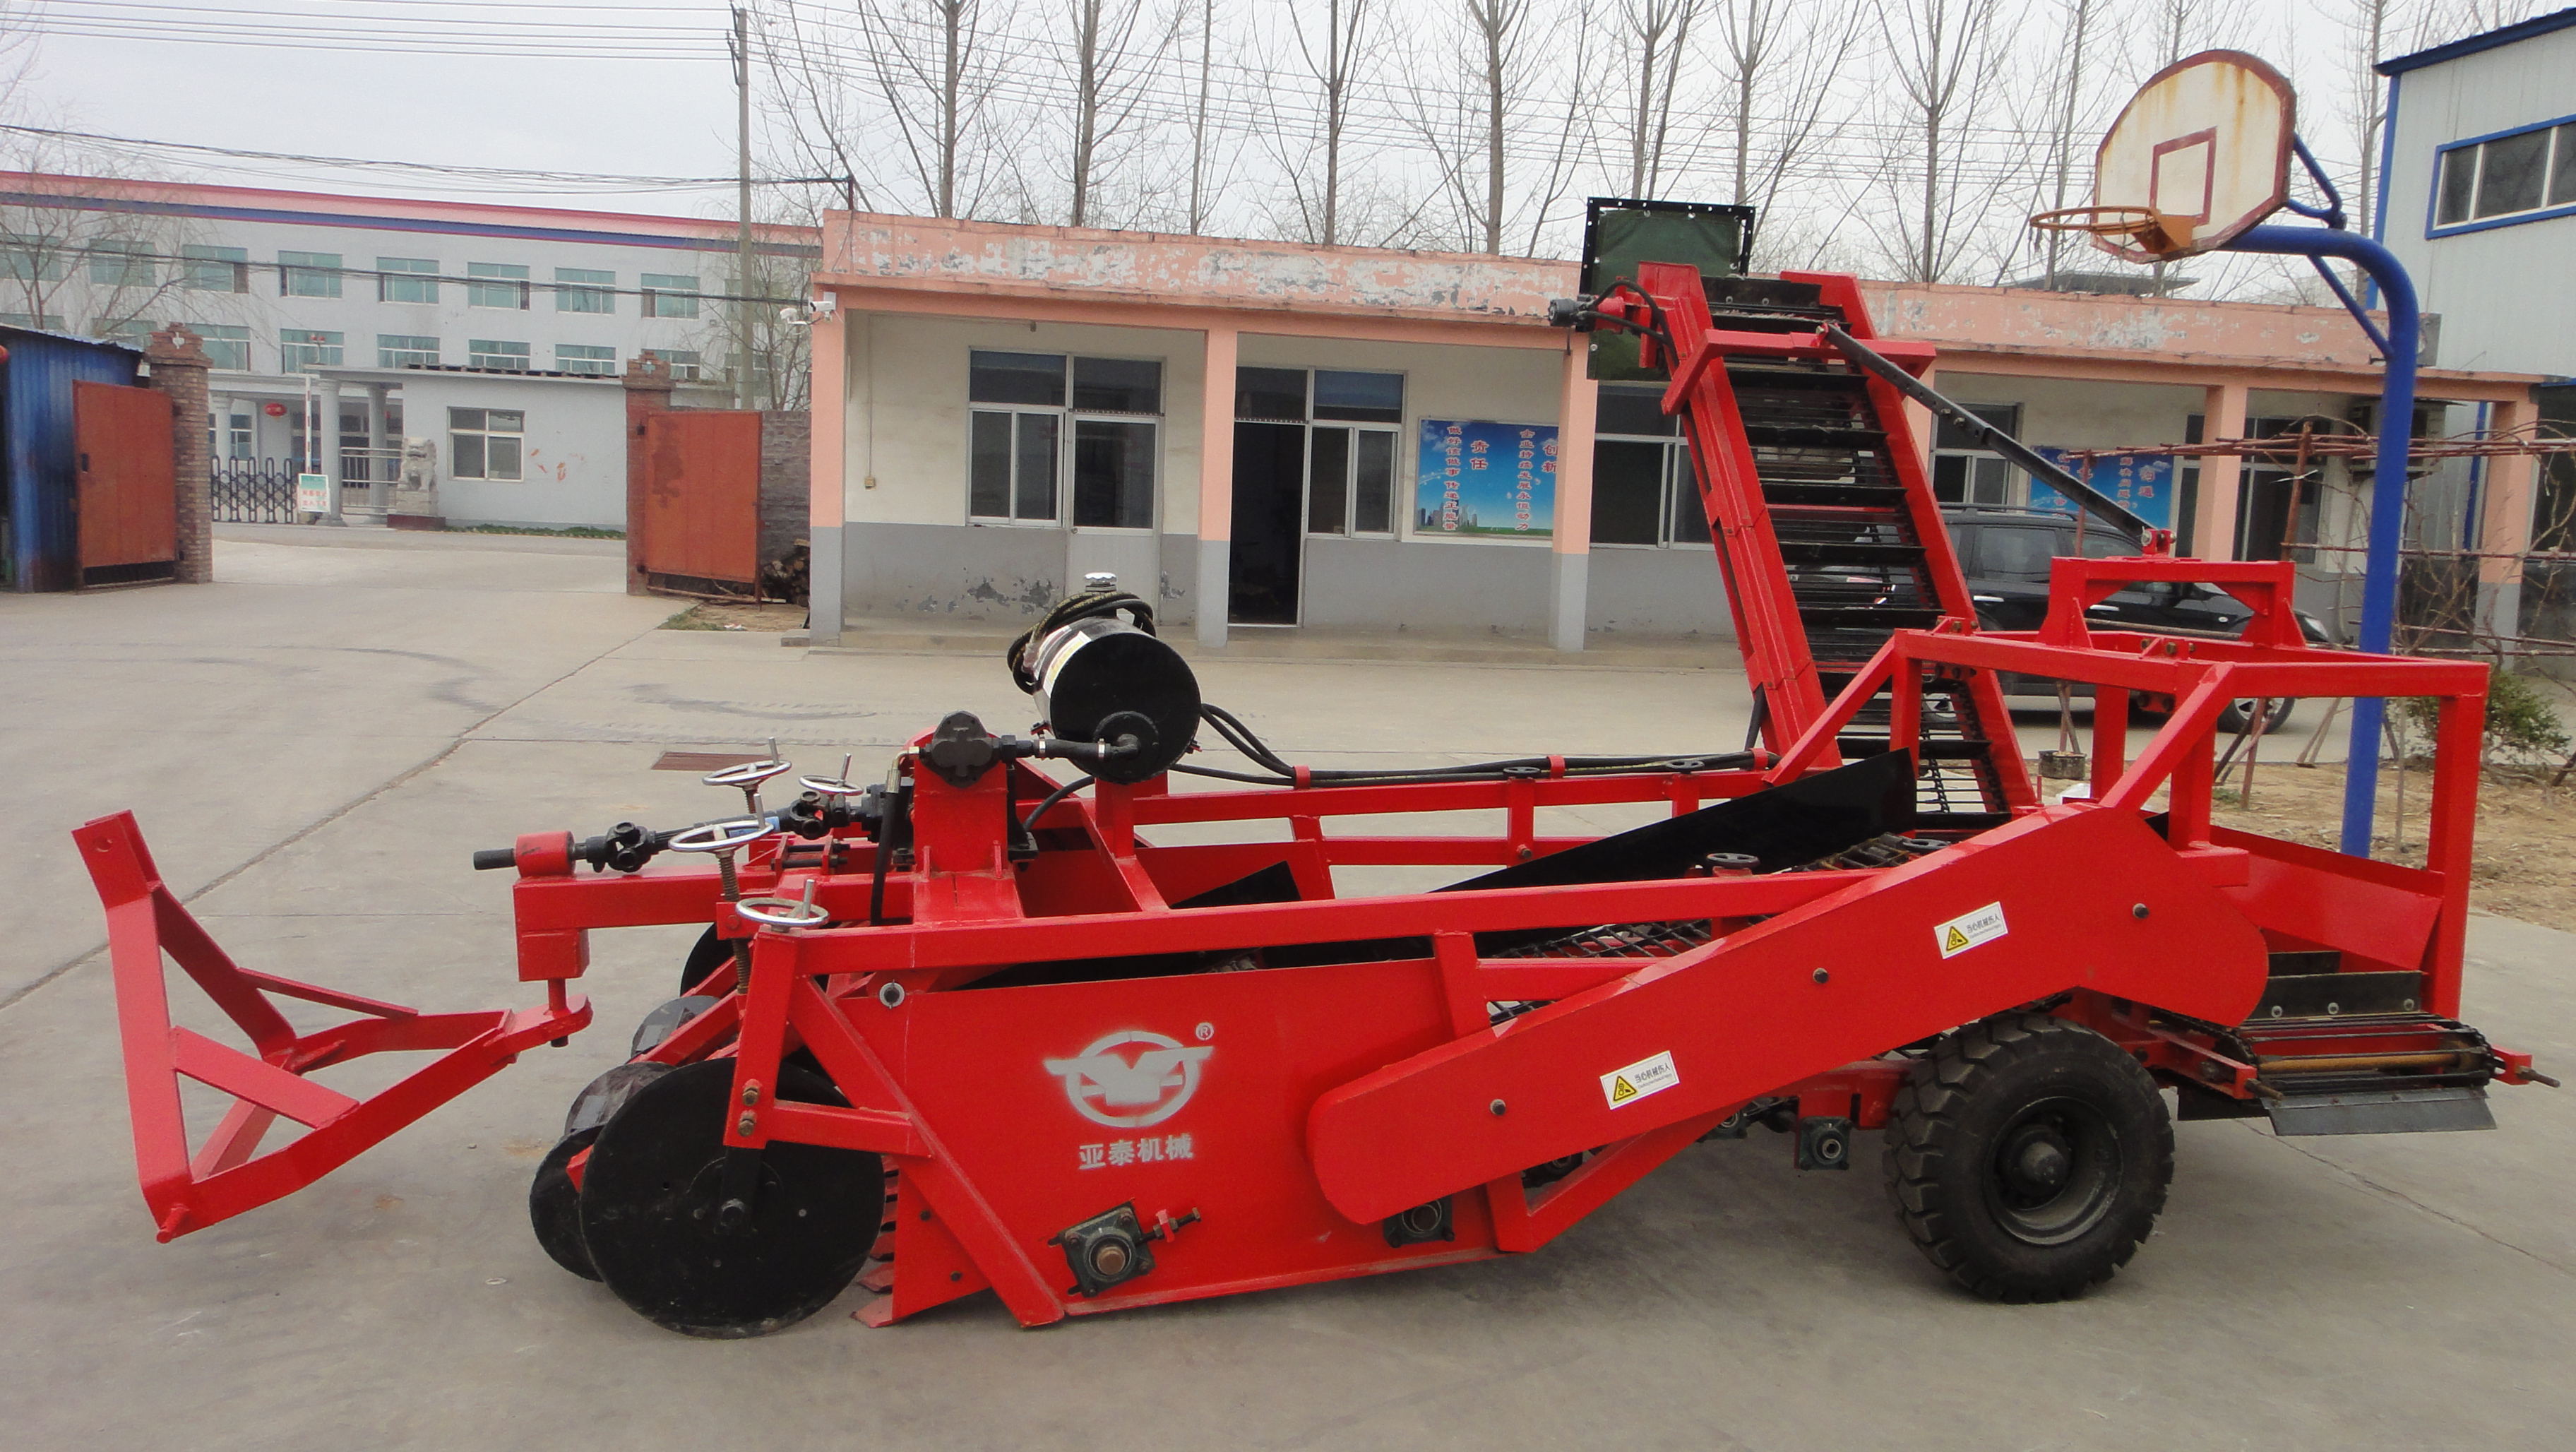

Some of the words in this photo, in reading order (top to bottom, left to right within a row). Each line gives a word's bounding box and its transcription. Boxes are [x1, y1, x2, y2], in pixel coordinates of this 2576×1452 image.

[1469, 440, 1489, 470] 责任
[1542, 445, 1558, 473] 创新
[1515, 429, 1535, 531] 企业持续发展永恒动力
[1443, 481, 1460, 530] 传递正能量
[1634, 1063, 1671, 1083] 当心机械伤人
[1079, 1133, 1193, 1170] 亚泰机械
